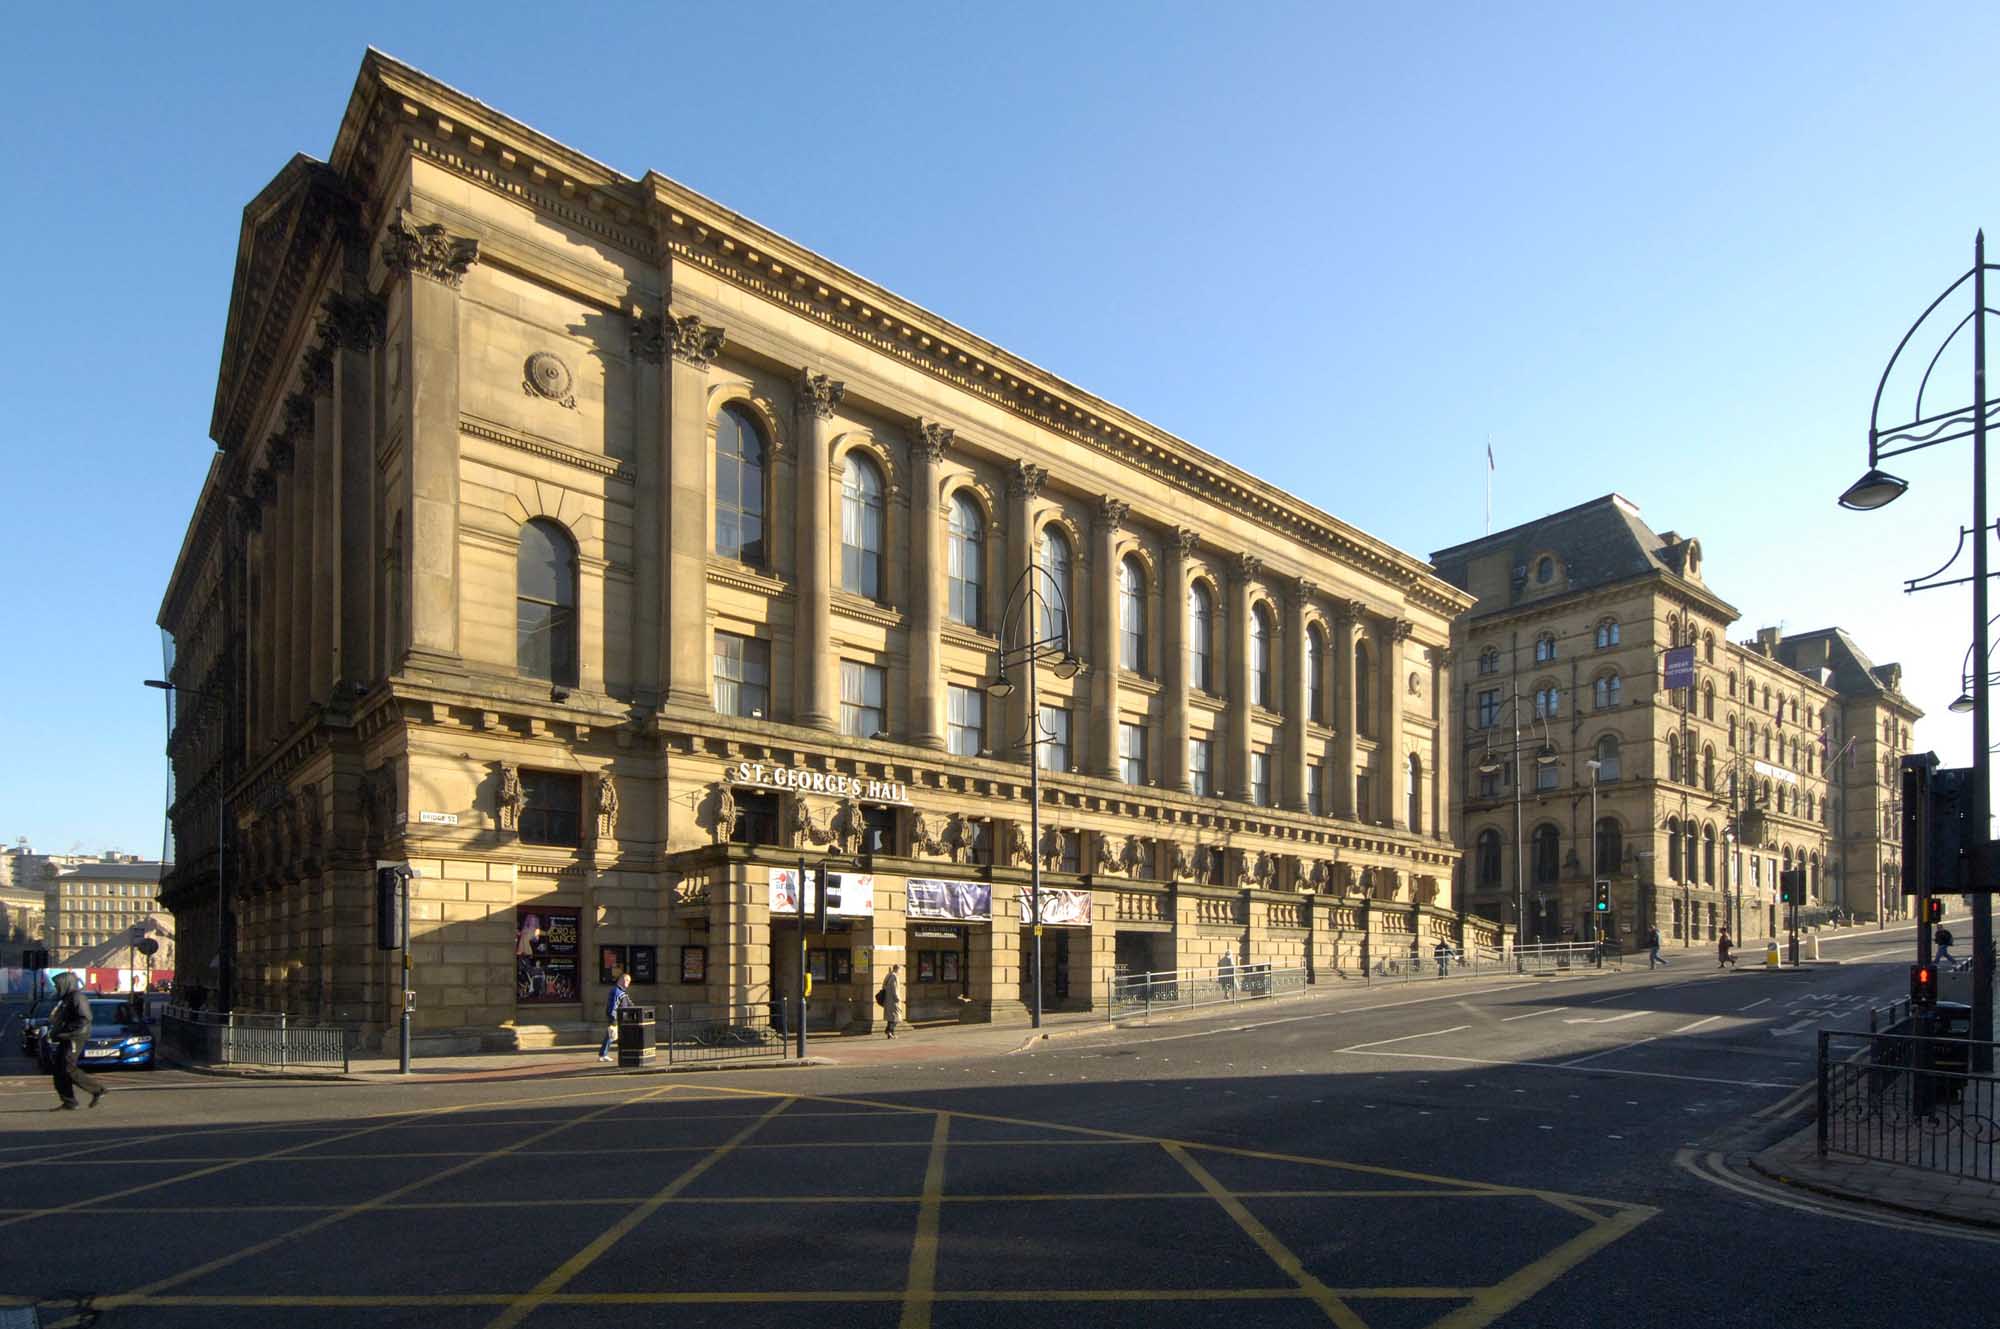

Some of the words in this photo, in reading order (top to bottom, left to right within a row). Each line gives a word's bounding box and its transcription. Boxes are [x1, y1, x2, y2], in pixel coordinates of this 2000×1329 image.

[774, 768, 861, 796] GEORGE'S
[869, 781, 909, 801] HALL
[422, 813, 445, 822] BRIDGE
[549, 935, 577, 944] DANCE
